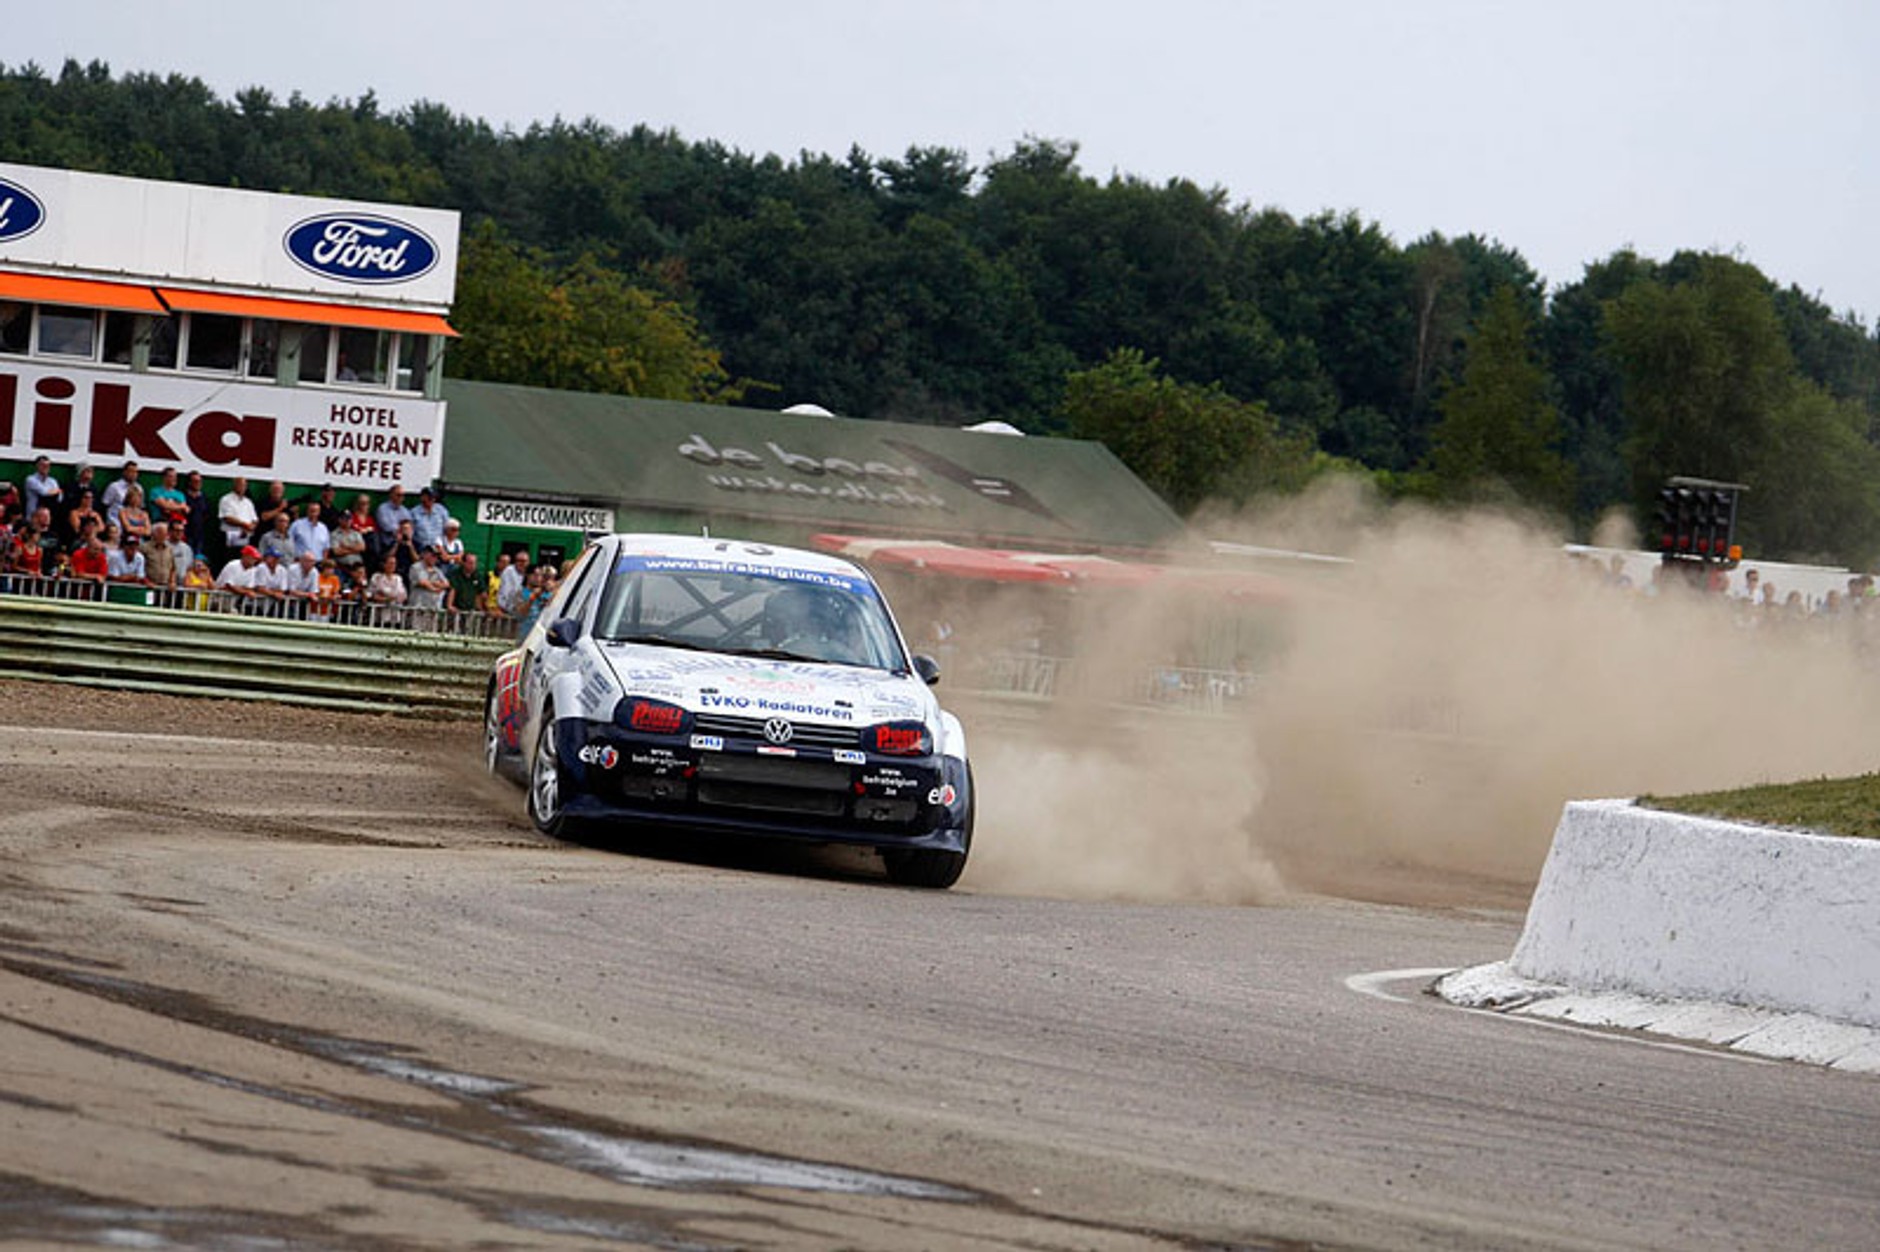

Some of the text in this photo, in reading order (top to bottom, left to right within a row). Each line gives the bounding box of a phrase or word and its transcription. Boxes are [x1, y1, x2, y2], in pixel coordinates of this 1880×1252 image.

[312, 219, 410, 273] Ford
[330, 403, 399, 429] HOTEL
[291, 427, 432, 457] RESTAURANT
[323, 455, 403, 480] KAFFEE
[485, 502, 608, 530] SPORTCOMMISSIE
